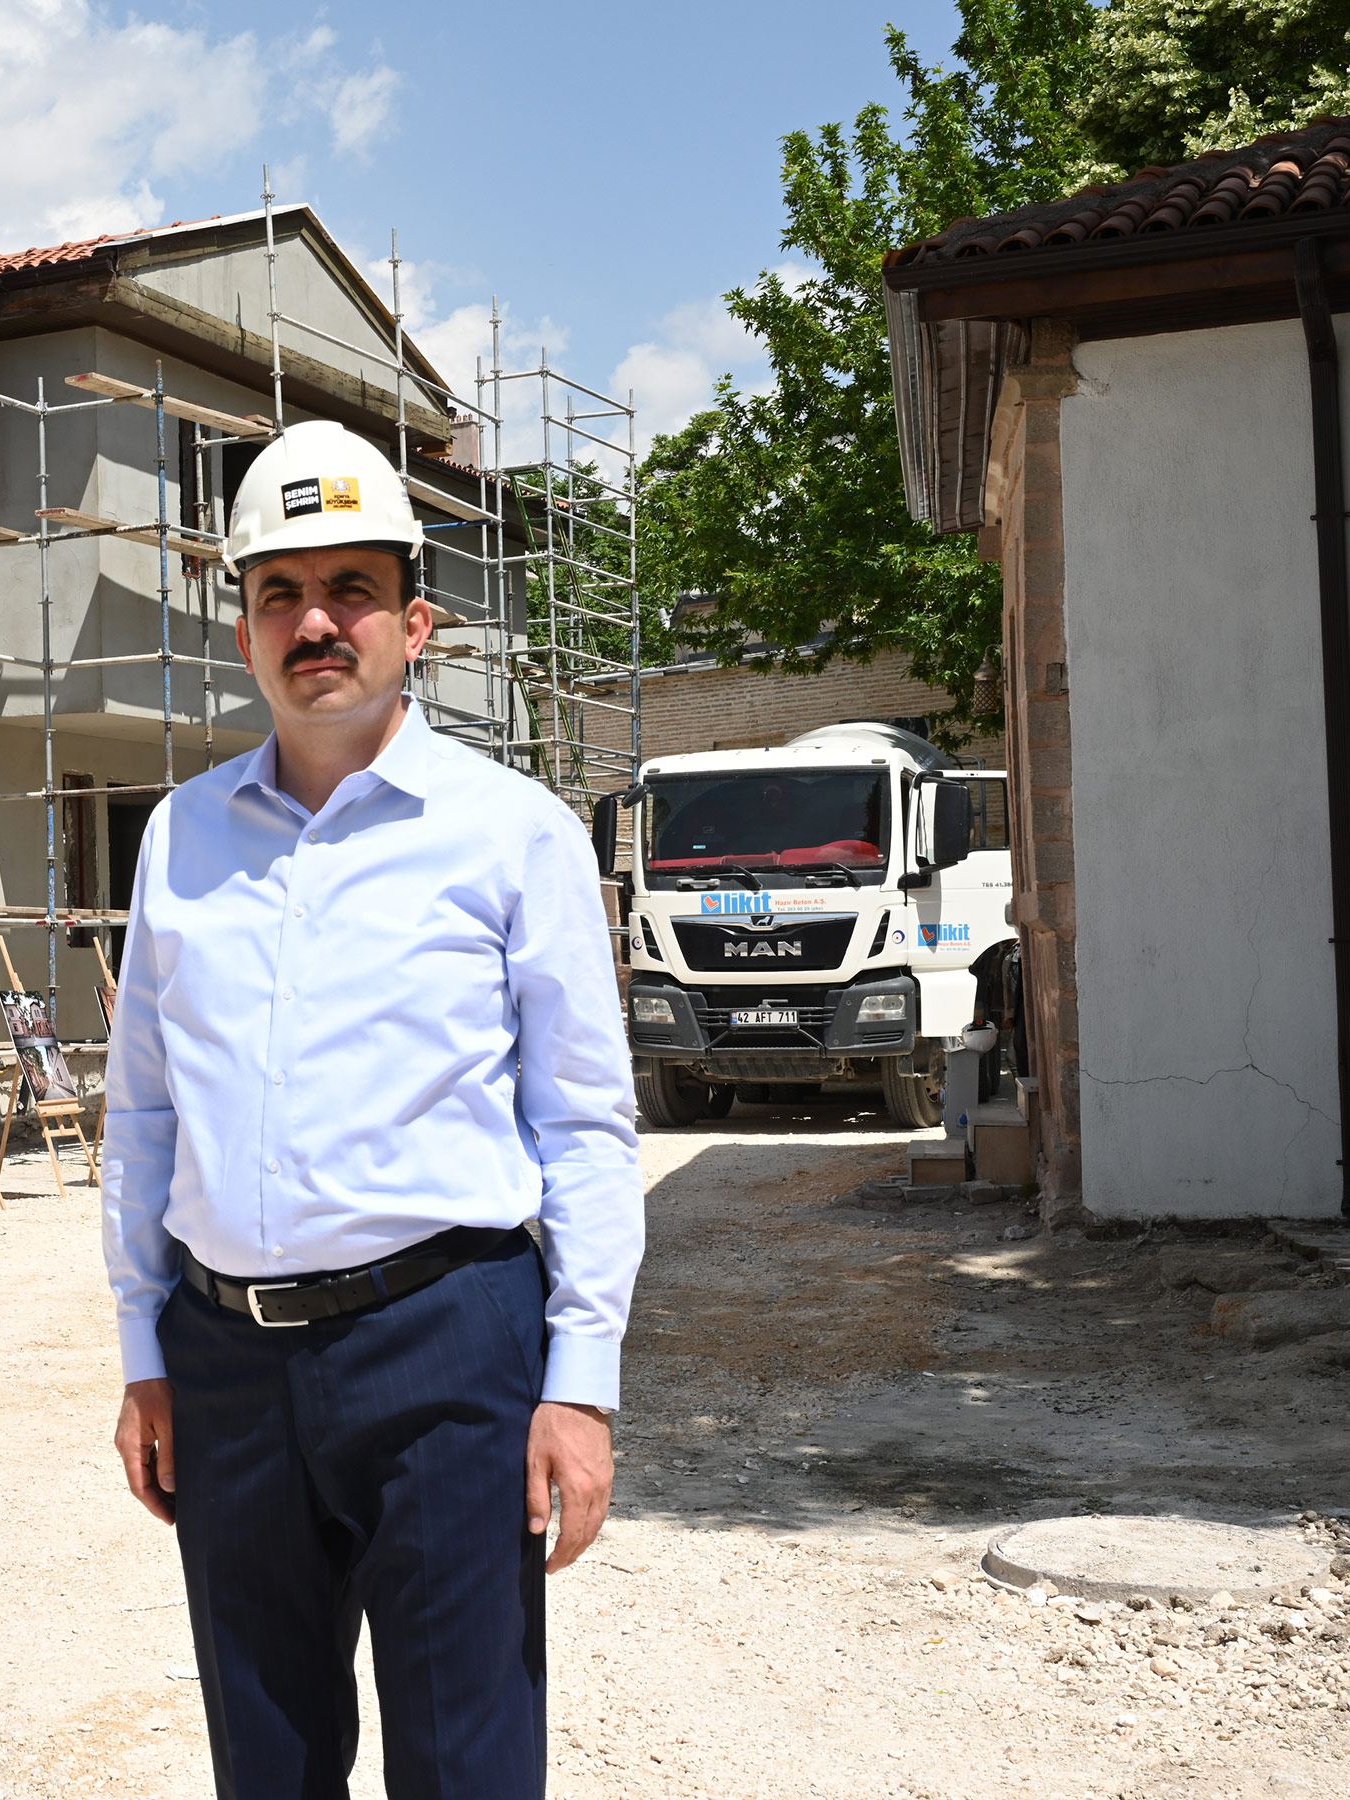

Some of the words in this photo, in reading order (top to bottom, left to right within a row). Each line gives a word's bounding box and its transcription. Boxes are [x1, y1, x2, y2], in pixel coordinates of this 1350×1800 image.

[724, 892, 771, 913] likit
[937, 924, 970, 941] likit
[724, 941, 802, 957] MAN
[738, 1012, 749, 1023] 42
[756, 1012, 772, 1023] AFT
[779, 1011, 796, 1022] 711
